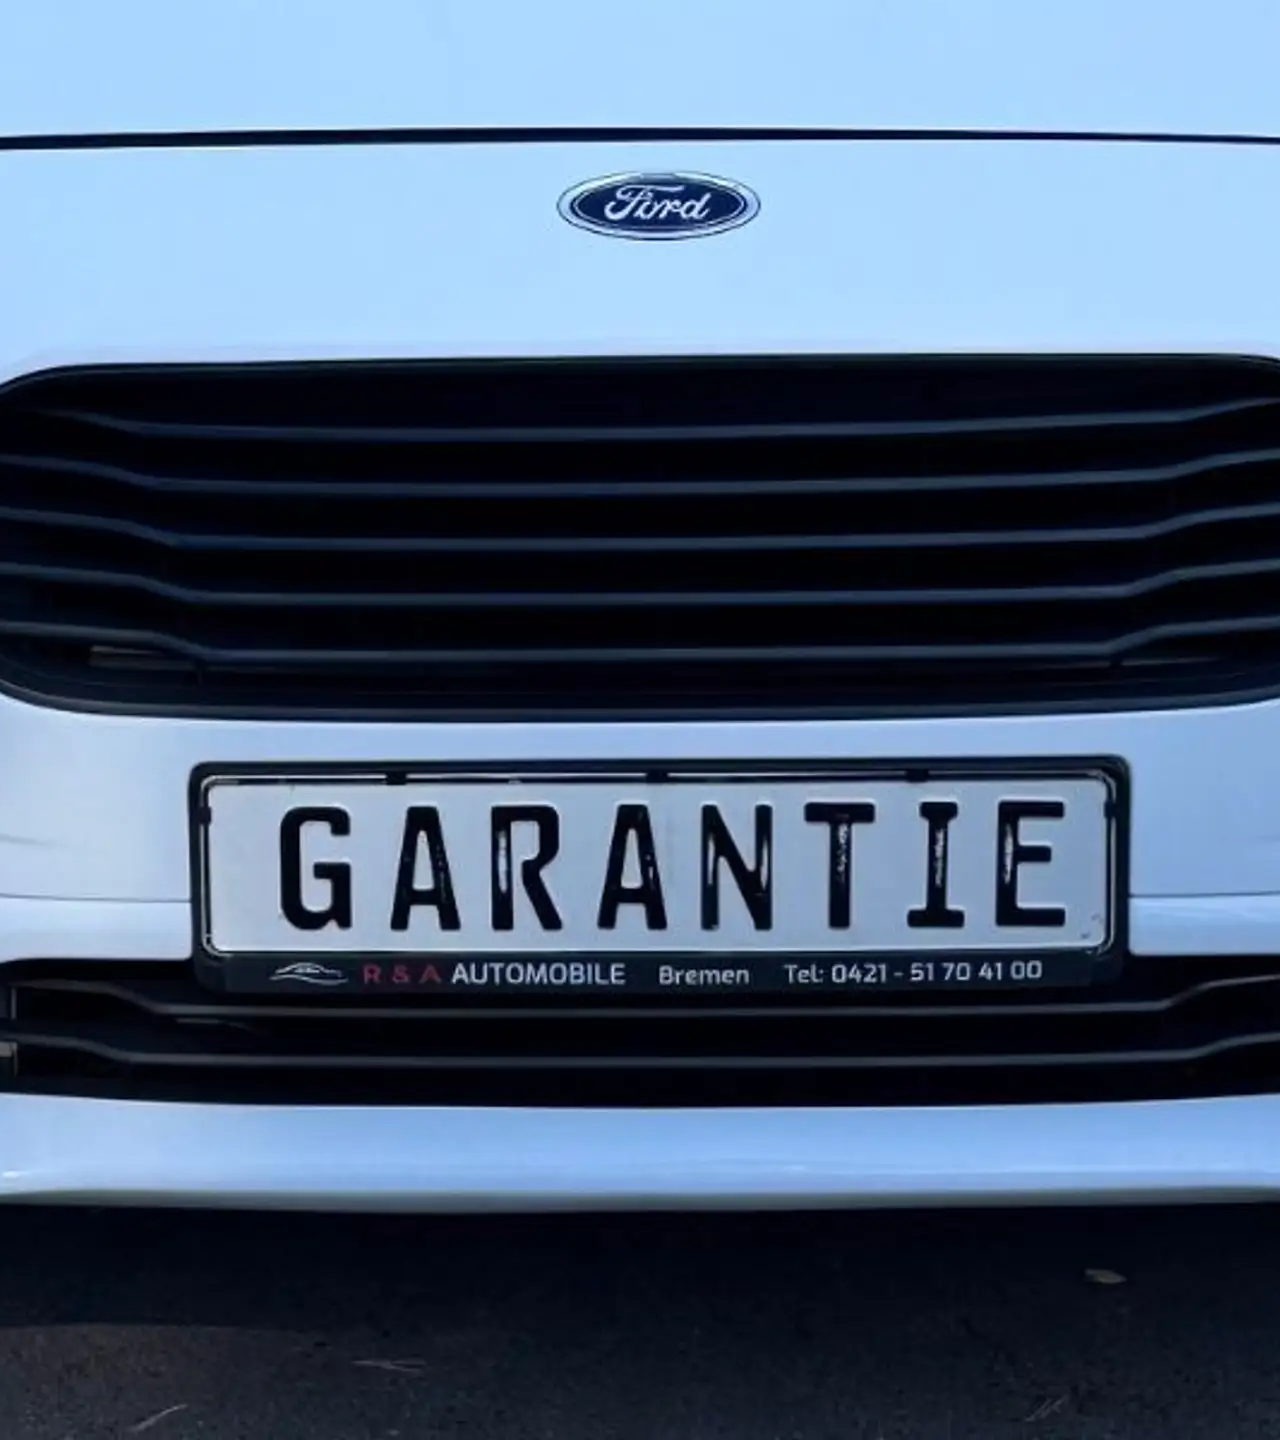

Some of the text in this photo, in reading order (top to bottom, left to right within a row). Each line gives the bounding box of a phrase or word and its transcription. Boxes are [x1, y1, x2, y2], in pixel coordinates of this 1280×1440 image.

[603, 183, 711, 221] Ford
[279, 801, 1066, 931] GARANTIE
[361, 963, 381, 984] R
[391, 963, 410, 984] &
[419, 962, 443, 984] A
[451, 962, 626, 985] AUTOMOBILE
[658, 964, 750, 986] Bremen
[783, 963, 824, 984] Tel:
[831, 963, 887, 984] 0421
[910, 962, 934, 982] 51
[940, 962, 971, 982] 70
[978, 962, 1003, 981] 41
[1009, 960, 1043, 980] 00
